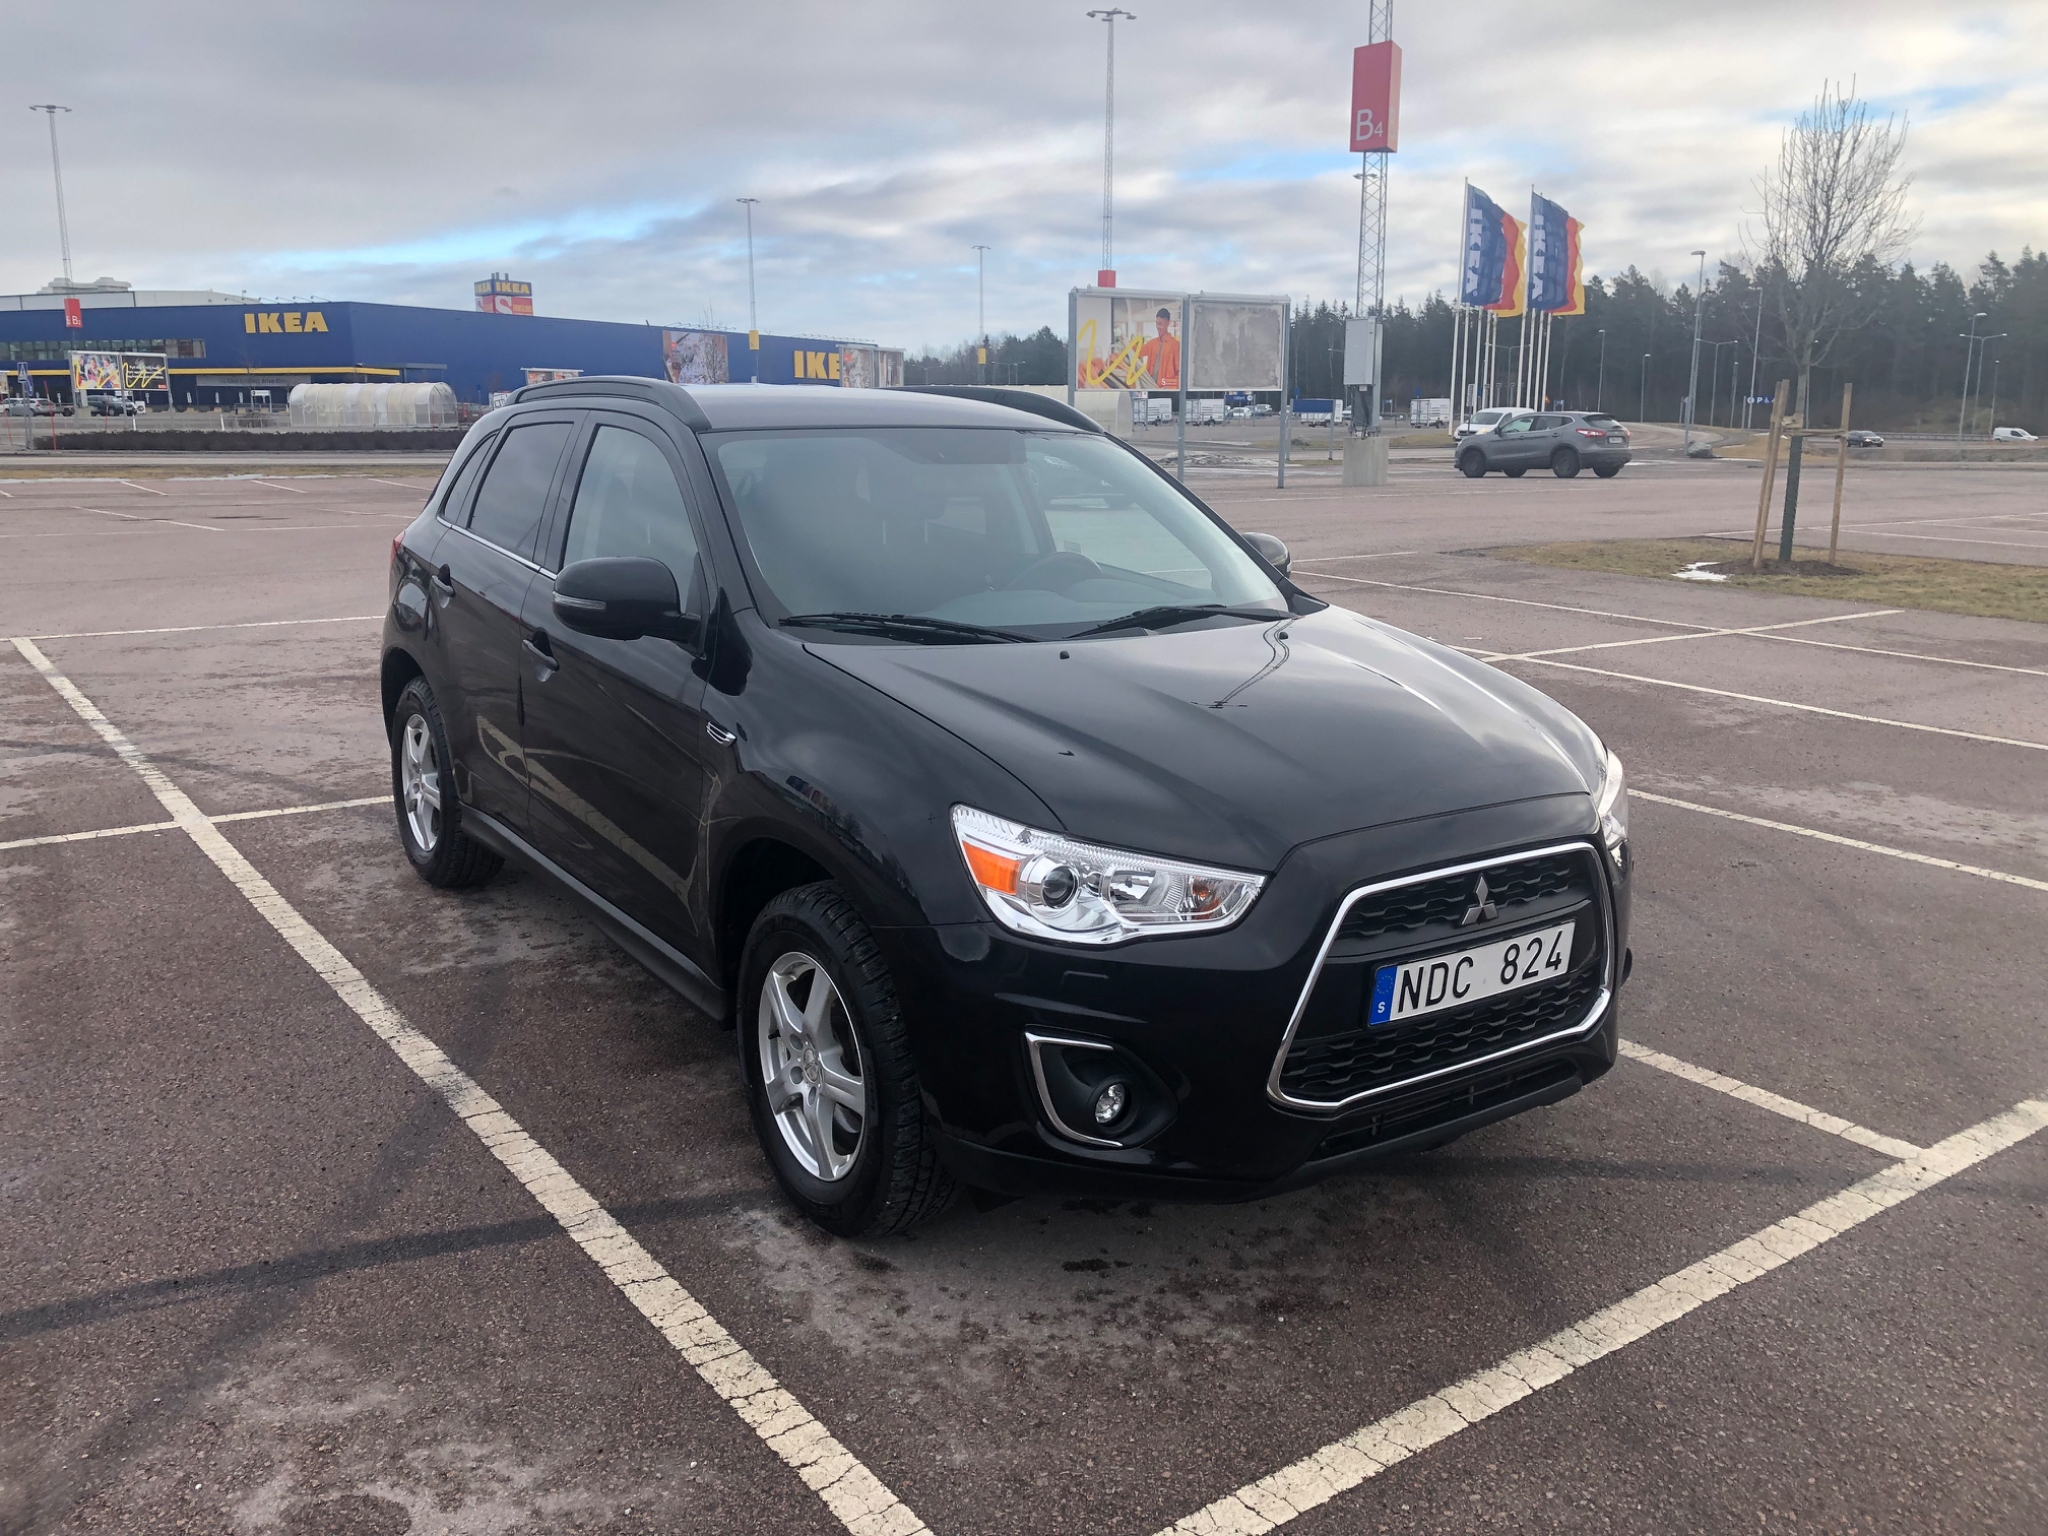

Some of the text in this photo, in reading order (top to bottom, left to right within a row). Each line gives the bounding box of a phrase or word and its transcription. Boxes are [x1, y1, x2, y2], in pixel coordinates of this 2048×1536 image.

[1356, 108, 1384, 141] B4
[1466, 208, 1482, 294] IKEA
[1532, 214, 1545, 300] IKEA
[495, 281, 530, 294] IKEA
[244, 312, 329, 334] IKEA
[793, 350, 839, 380] IKE
[1397, 930, 1563, 1013] NDC 824
[1377, 1001, 1386, 1014] S
